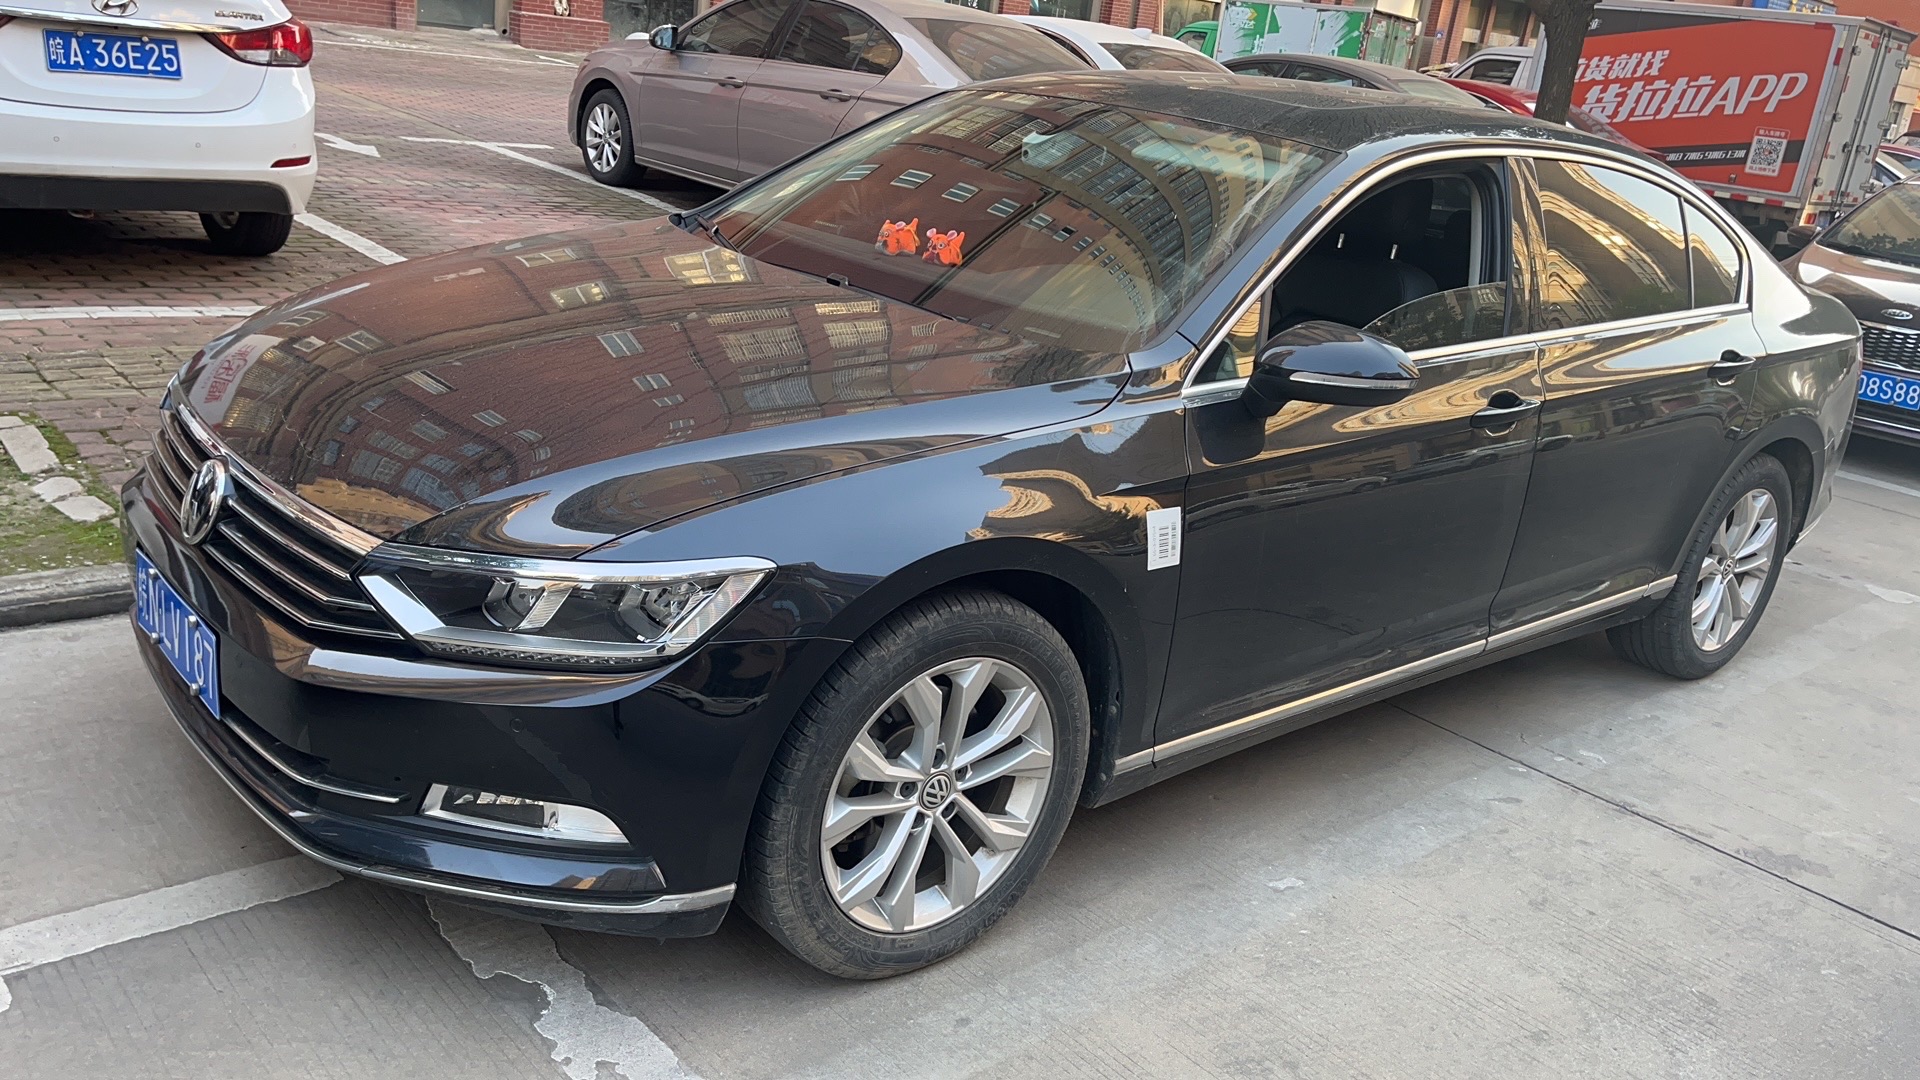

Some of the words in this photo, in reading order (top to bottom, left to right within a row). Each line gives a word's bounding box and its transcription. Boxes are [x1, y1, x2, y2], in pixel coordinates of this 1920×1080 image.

[214, 10, 265, 22] ELANTRA
[1581, 72, 1809, 123] 货拉拉APP
